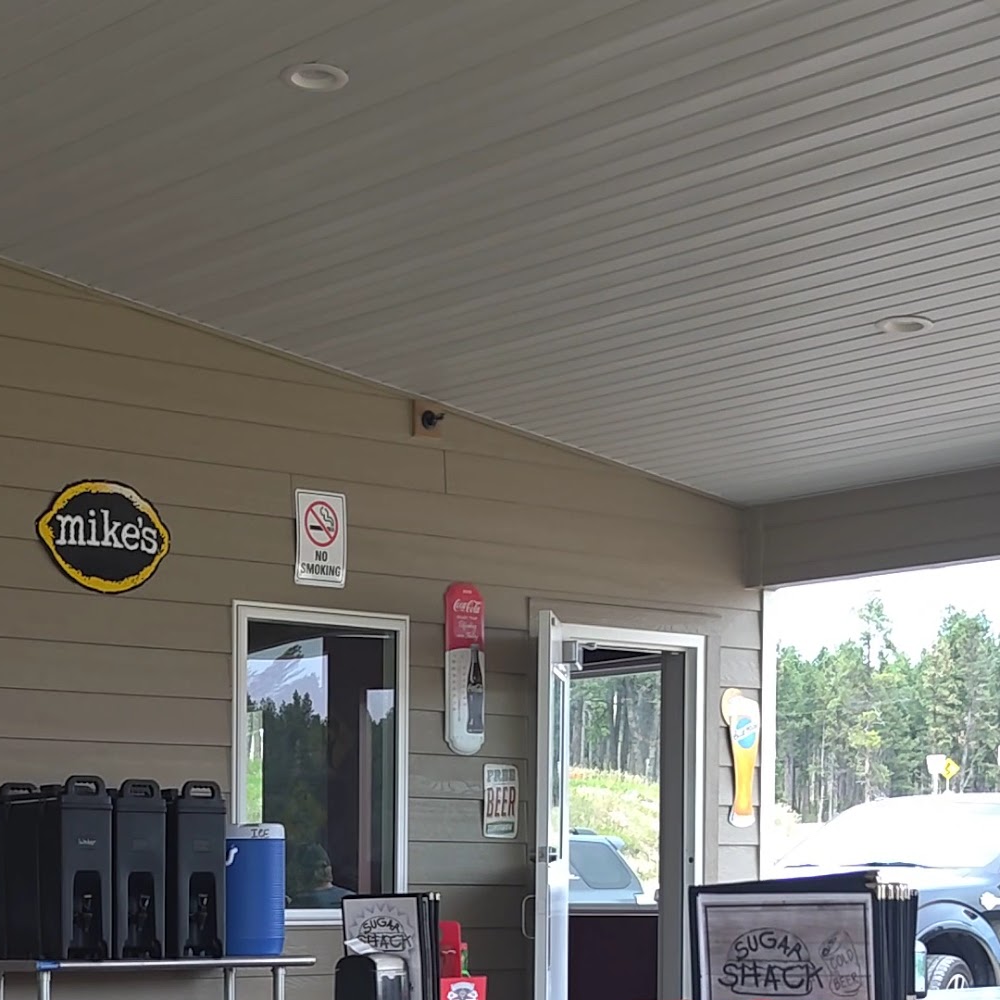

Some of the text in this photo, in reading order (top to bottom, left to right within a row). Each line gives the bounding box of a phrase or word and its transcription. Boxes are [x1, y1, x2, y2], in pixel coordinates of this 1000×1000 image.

[55, 509, 159, 555] mike's
[300, 562, 341, 577] SMOKING
[315, 550, 328, 562] NO
[486, 786, 516, 817] BEER
[362, 917, 400, 934] SUGAR
[734, 930, 803, 963] SUGAR
[717, 959, 825, 992] SHACK
